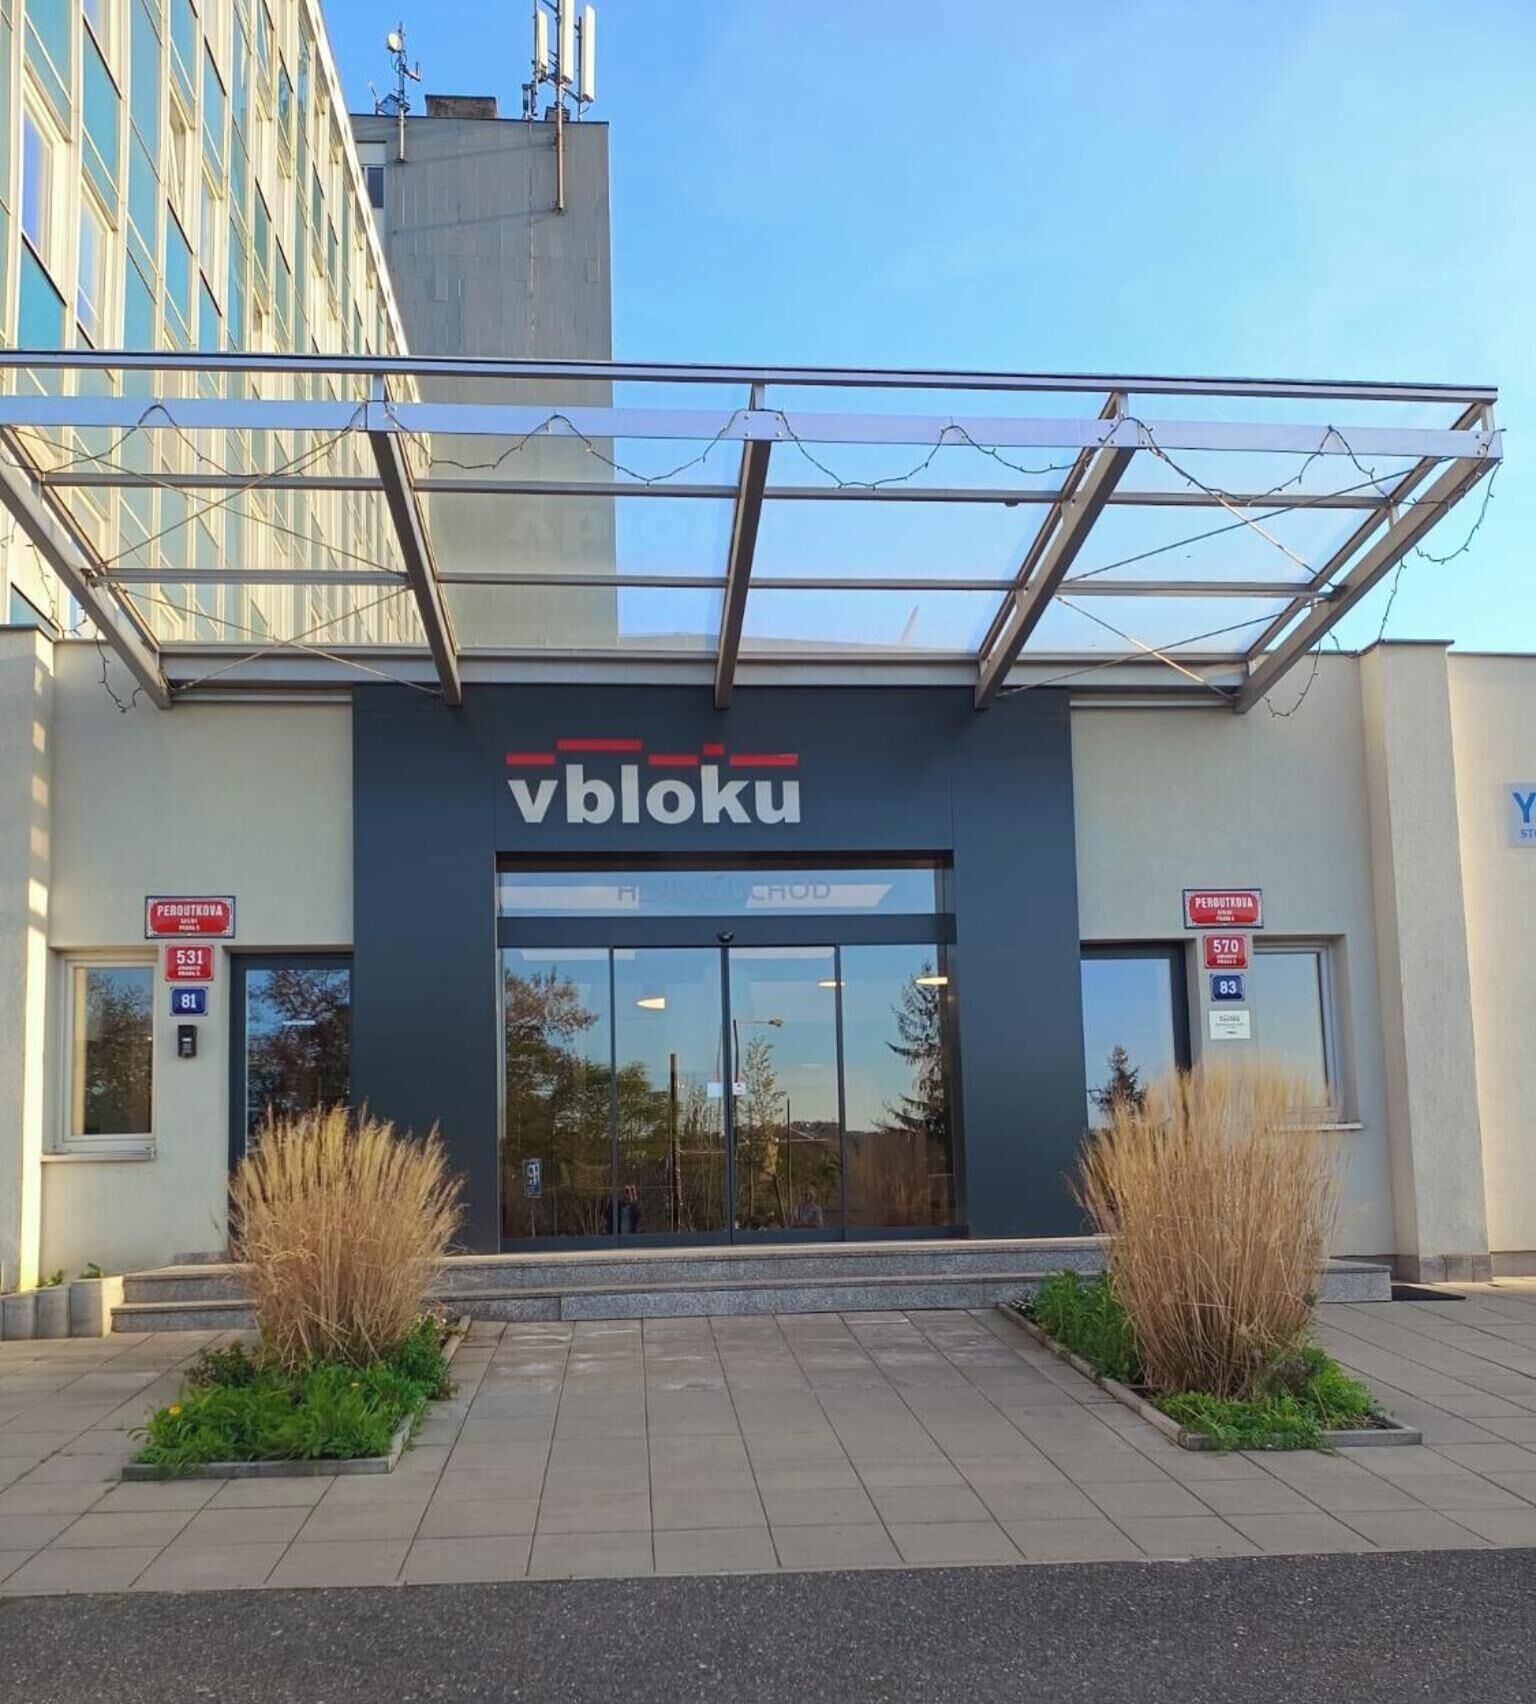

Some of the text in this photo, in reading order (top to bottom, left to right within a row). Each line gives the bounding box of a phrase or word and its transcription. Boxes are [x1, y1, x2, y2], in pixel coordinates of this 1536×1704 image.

[507, 763, 801, 824] vbloku
[1520, 829, 1536, 840] ST
[1195, 896, 1254, 908] PEROUTKOVA
[156, 904, 223, 917] PEROUTKOVA
[1213, 940, 1239, 953] 570
[176, 949, 203, 965] 531
[1219, 980, 1237, 995] 83
[180, 993, 196, 1009] 81
